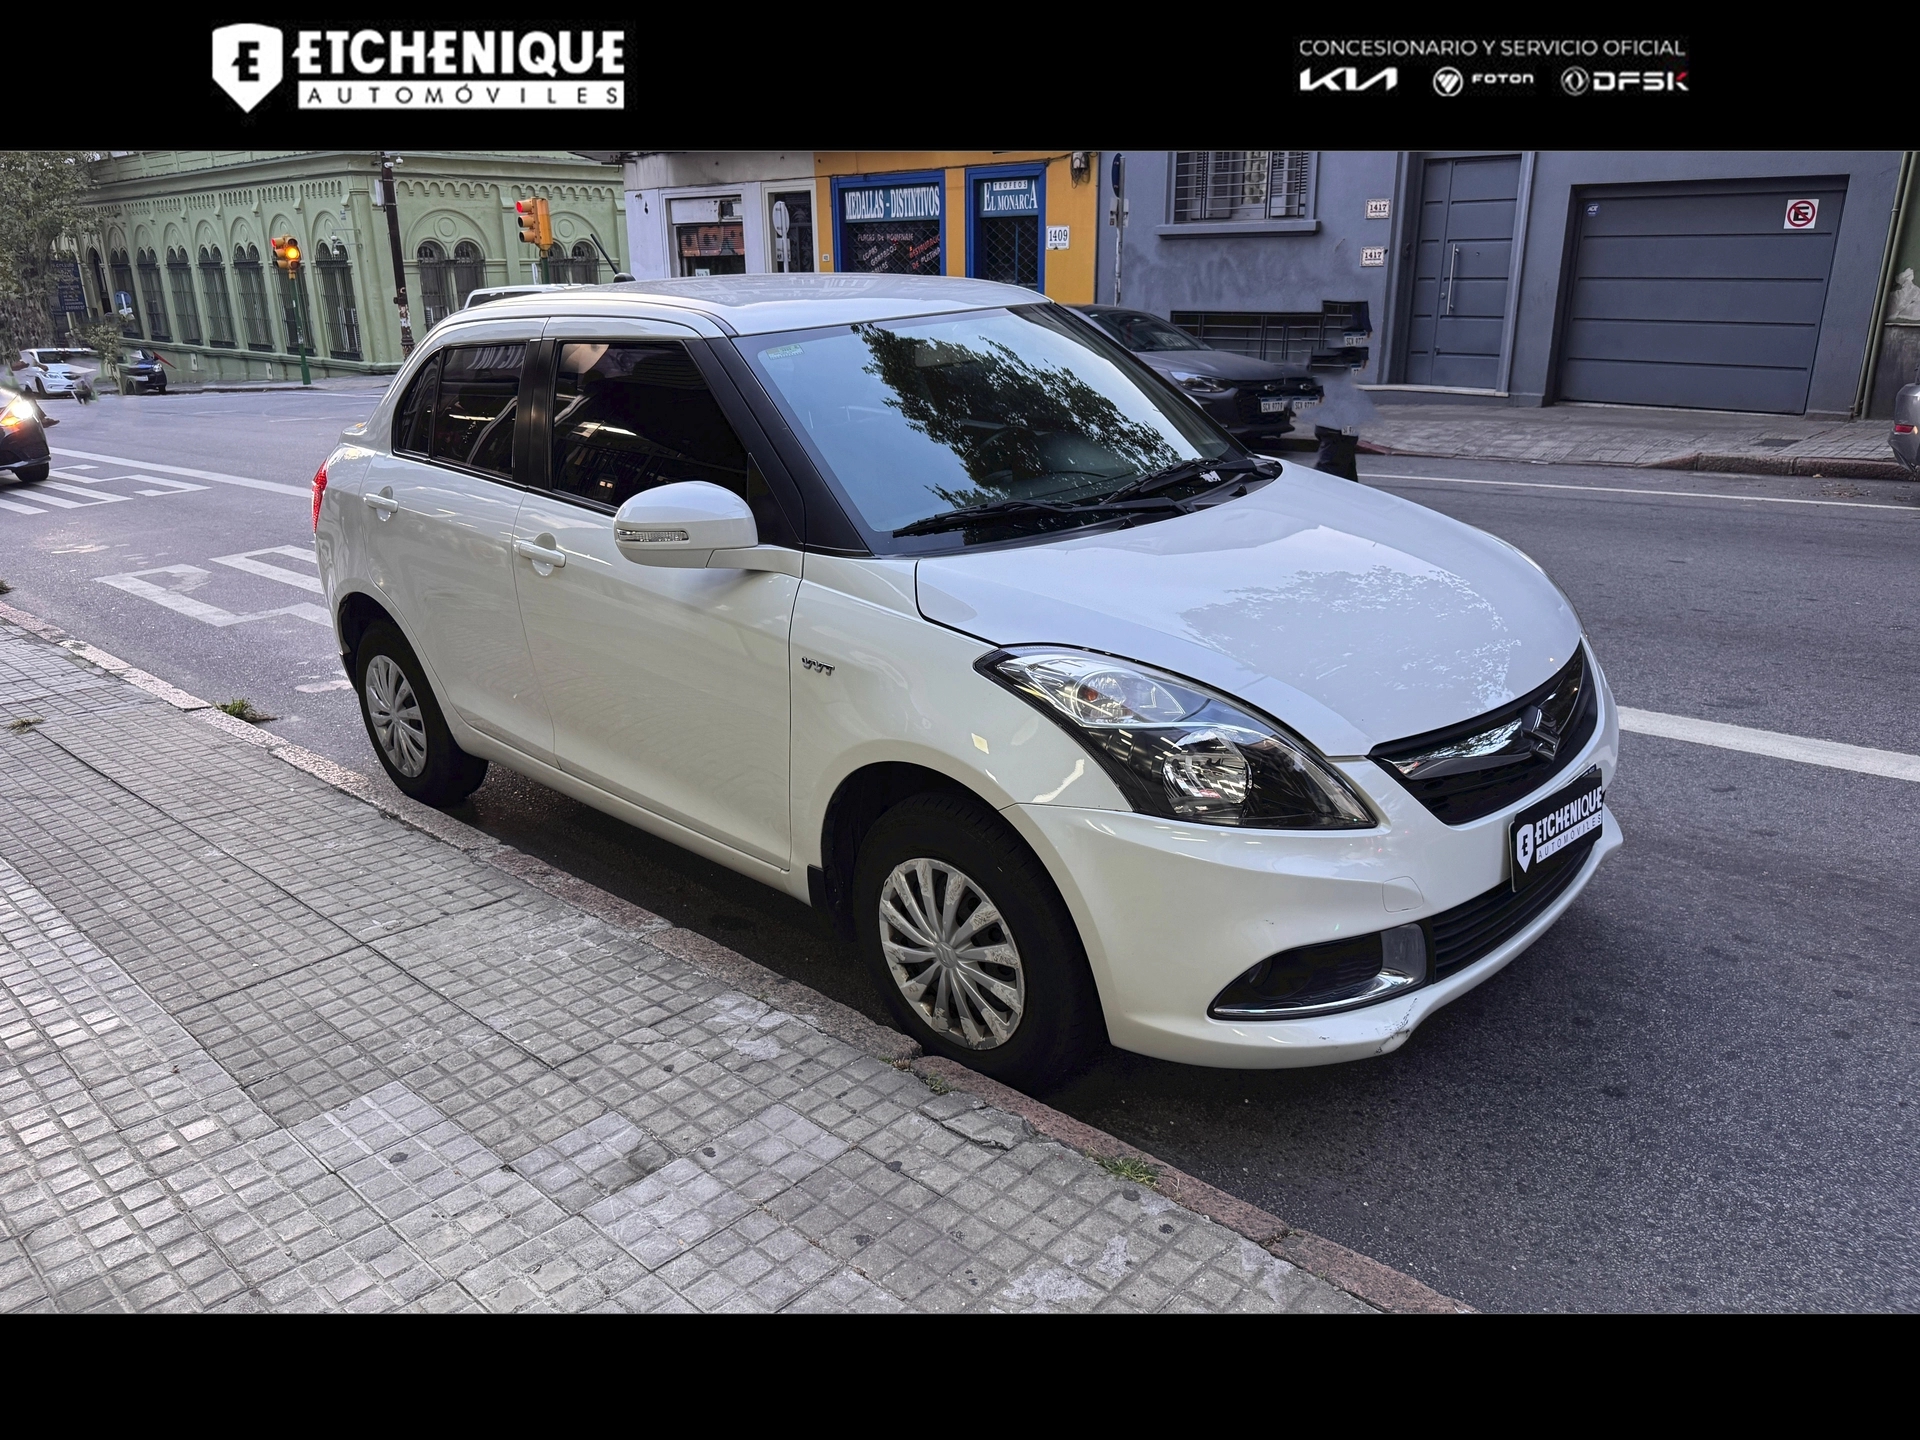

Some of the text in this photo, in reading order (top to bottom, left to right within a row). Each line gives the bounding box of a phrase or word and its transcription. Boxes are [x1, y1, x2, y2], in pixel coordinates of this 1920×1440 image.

[994, 181, 1028, 190] TROFEOS
[997, 180, 1038, 211] MONARCA
[845, 190, 884, 220] MEDALLAS
[890, 186, 940, 218] DISTINTIVOS
[1049, 229, 1068, 242] 1409
[1535, 785, 1602, 846] ETCHENIQUE
